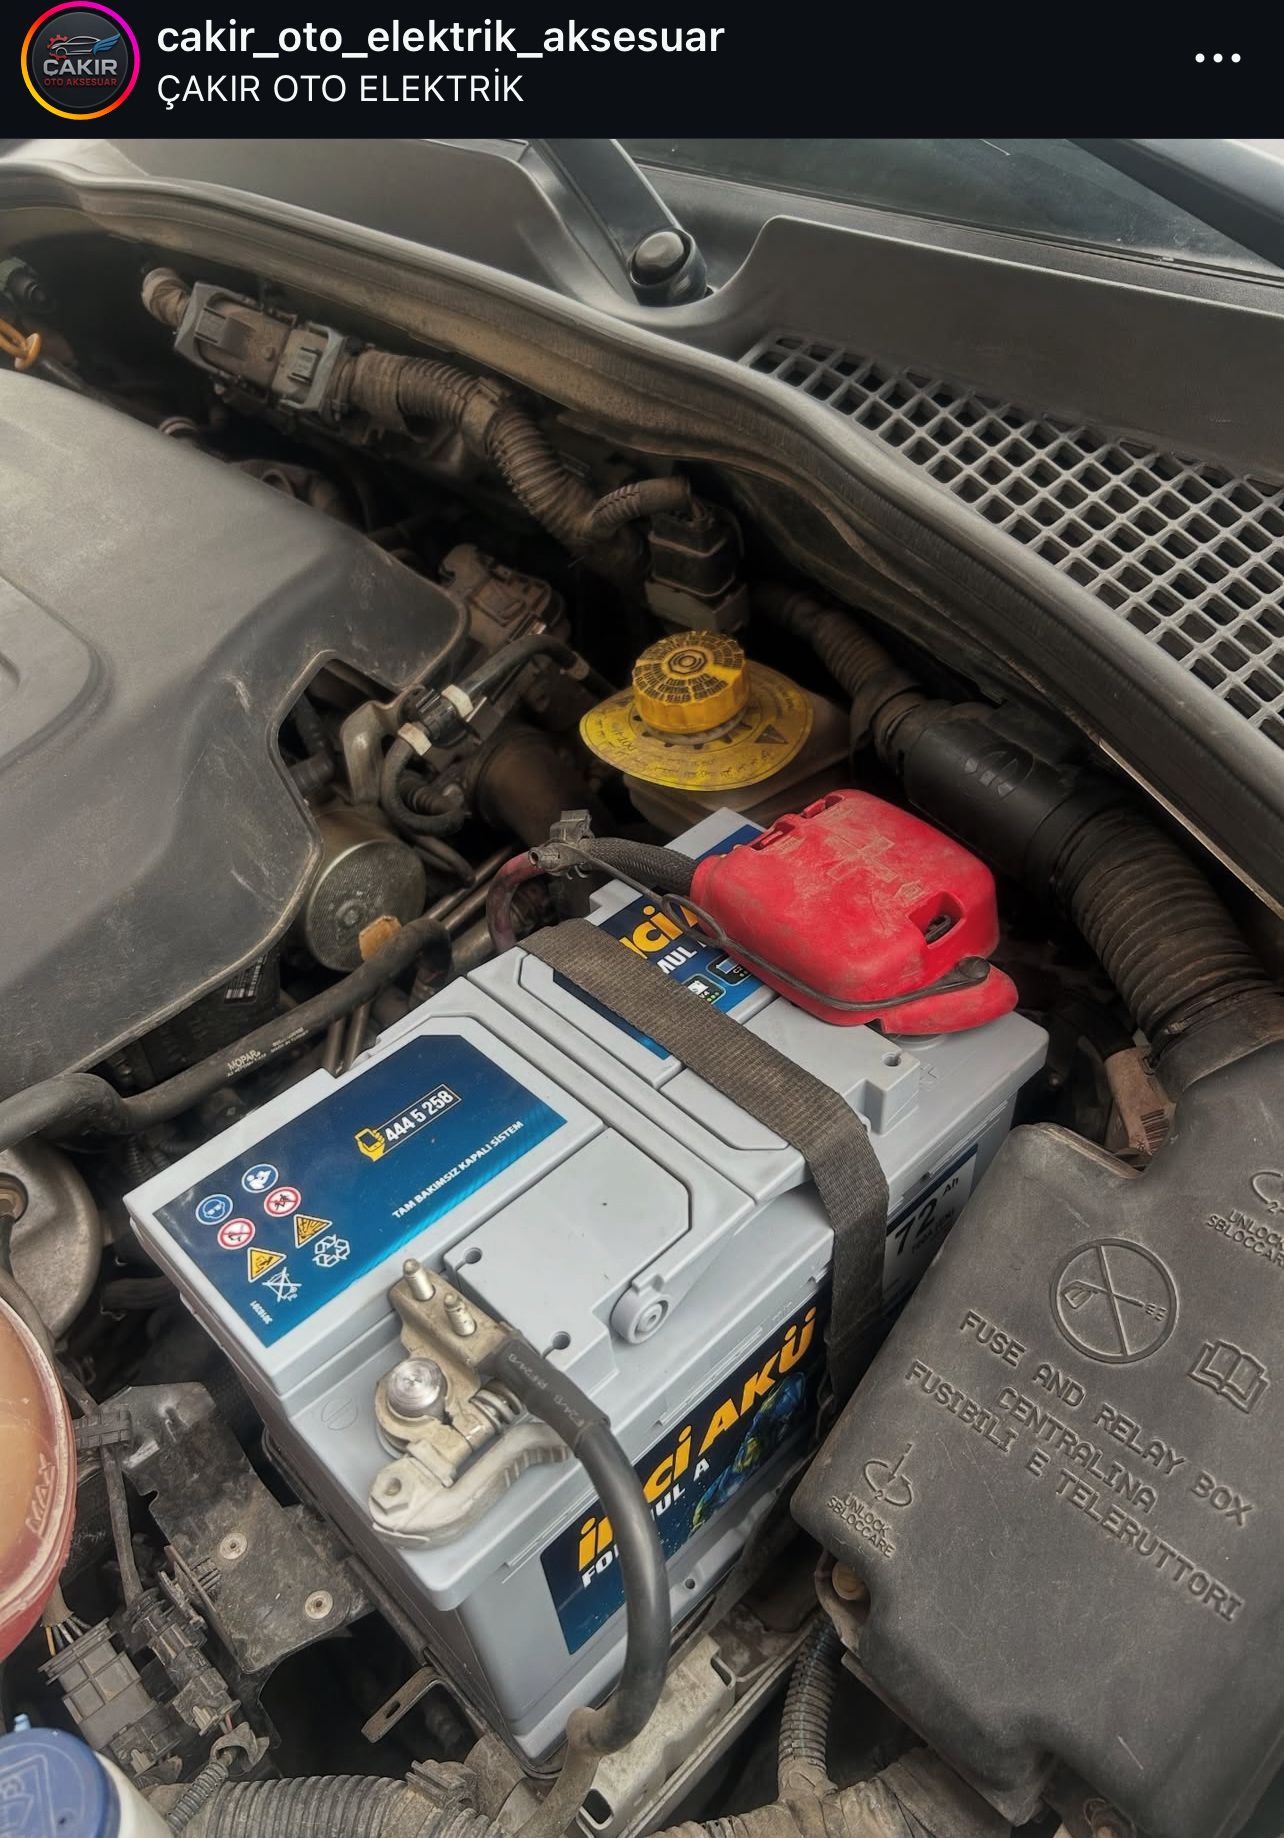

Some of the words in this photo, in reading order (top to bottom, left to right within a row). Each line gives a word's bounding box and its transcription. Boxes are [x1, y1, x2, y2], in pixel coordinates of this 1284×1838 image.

[384, 1116, 416, 1142] 444
[410, 1108, 427, 1124] 5
[422, 1090, 454, 1115] 258
[391, 1201, 417, 1219] TAM
[413, 1166, 461, 1205] BAKIMSIZ
[458, 1143, 493, 1172] KAPALI
[489, 1120, 524, 1148] SİSTEM
[895, 1198, 938, 1255] 72
[698, 1306, 817, 1457] AKÜ
[959, 1309, 1027, 1368] FUSE
[1032, 1361, 1087, 1408] AND
[1093, 1402, 1187, 1476] RELAY
[1190, 1470, 1254, 1528] BOX
[904, 1359, 1020, 1455] FUSIBILI
[1024, 1447, 1052, 1479] E
[1054, 1467, 1247, 1623] TELERUTTORI
[998, 1386, 1159, 1515] CENTRALINA
[581, 1483, 686, 1589] FOUL
[693, 1458, 710, 1482] A
[826, 1495, 897, 1559] SBLOCCARE
[842, 1492, 892, 1538] UNLOCK
